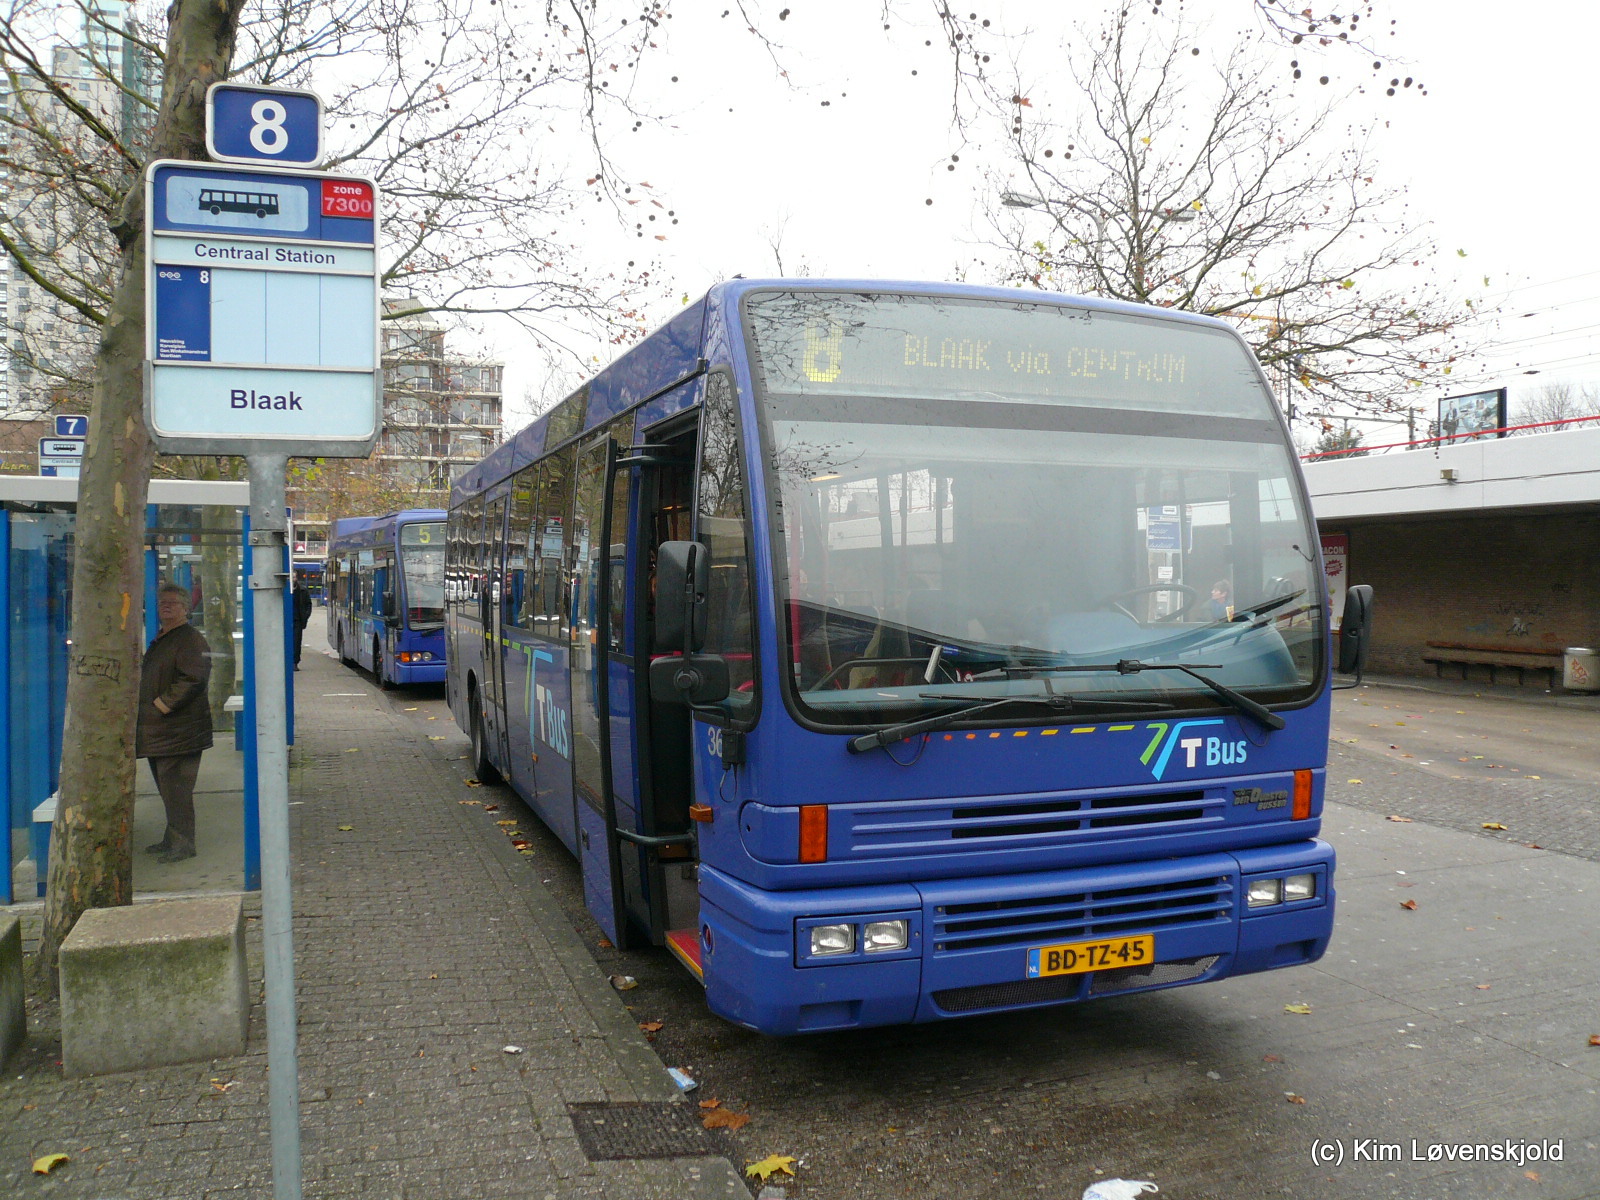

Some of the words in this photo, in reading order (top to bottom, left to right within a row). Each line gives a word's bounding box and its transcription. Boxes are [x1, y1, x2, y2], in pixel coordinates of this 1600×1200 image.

[249, 99, 289, 155] 8
[332, 185, 362, 195] zone
[324, 197, 372, 213] 7300
[194, 243, 269, 261] Centraal
[275, 248, 336, 265] Station
[200, 270, 209, 284] 8
[904, 334, 992, 371] BLAAK
[1007, 343, 1050, 375] via
[230, 389, 303, 411] Blaak
[66, 418, 78, 434] 7
[419, 526, 431, 543] 5
[1323, 546, 1344, 554] ACON
[1047, 940, 1145, 972] BD-TZ-45
